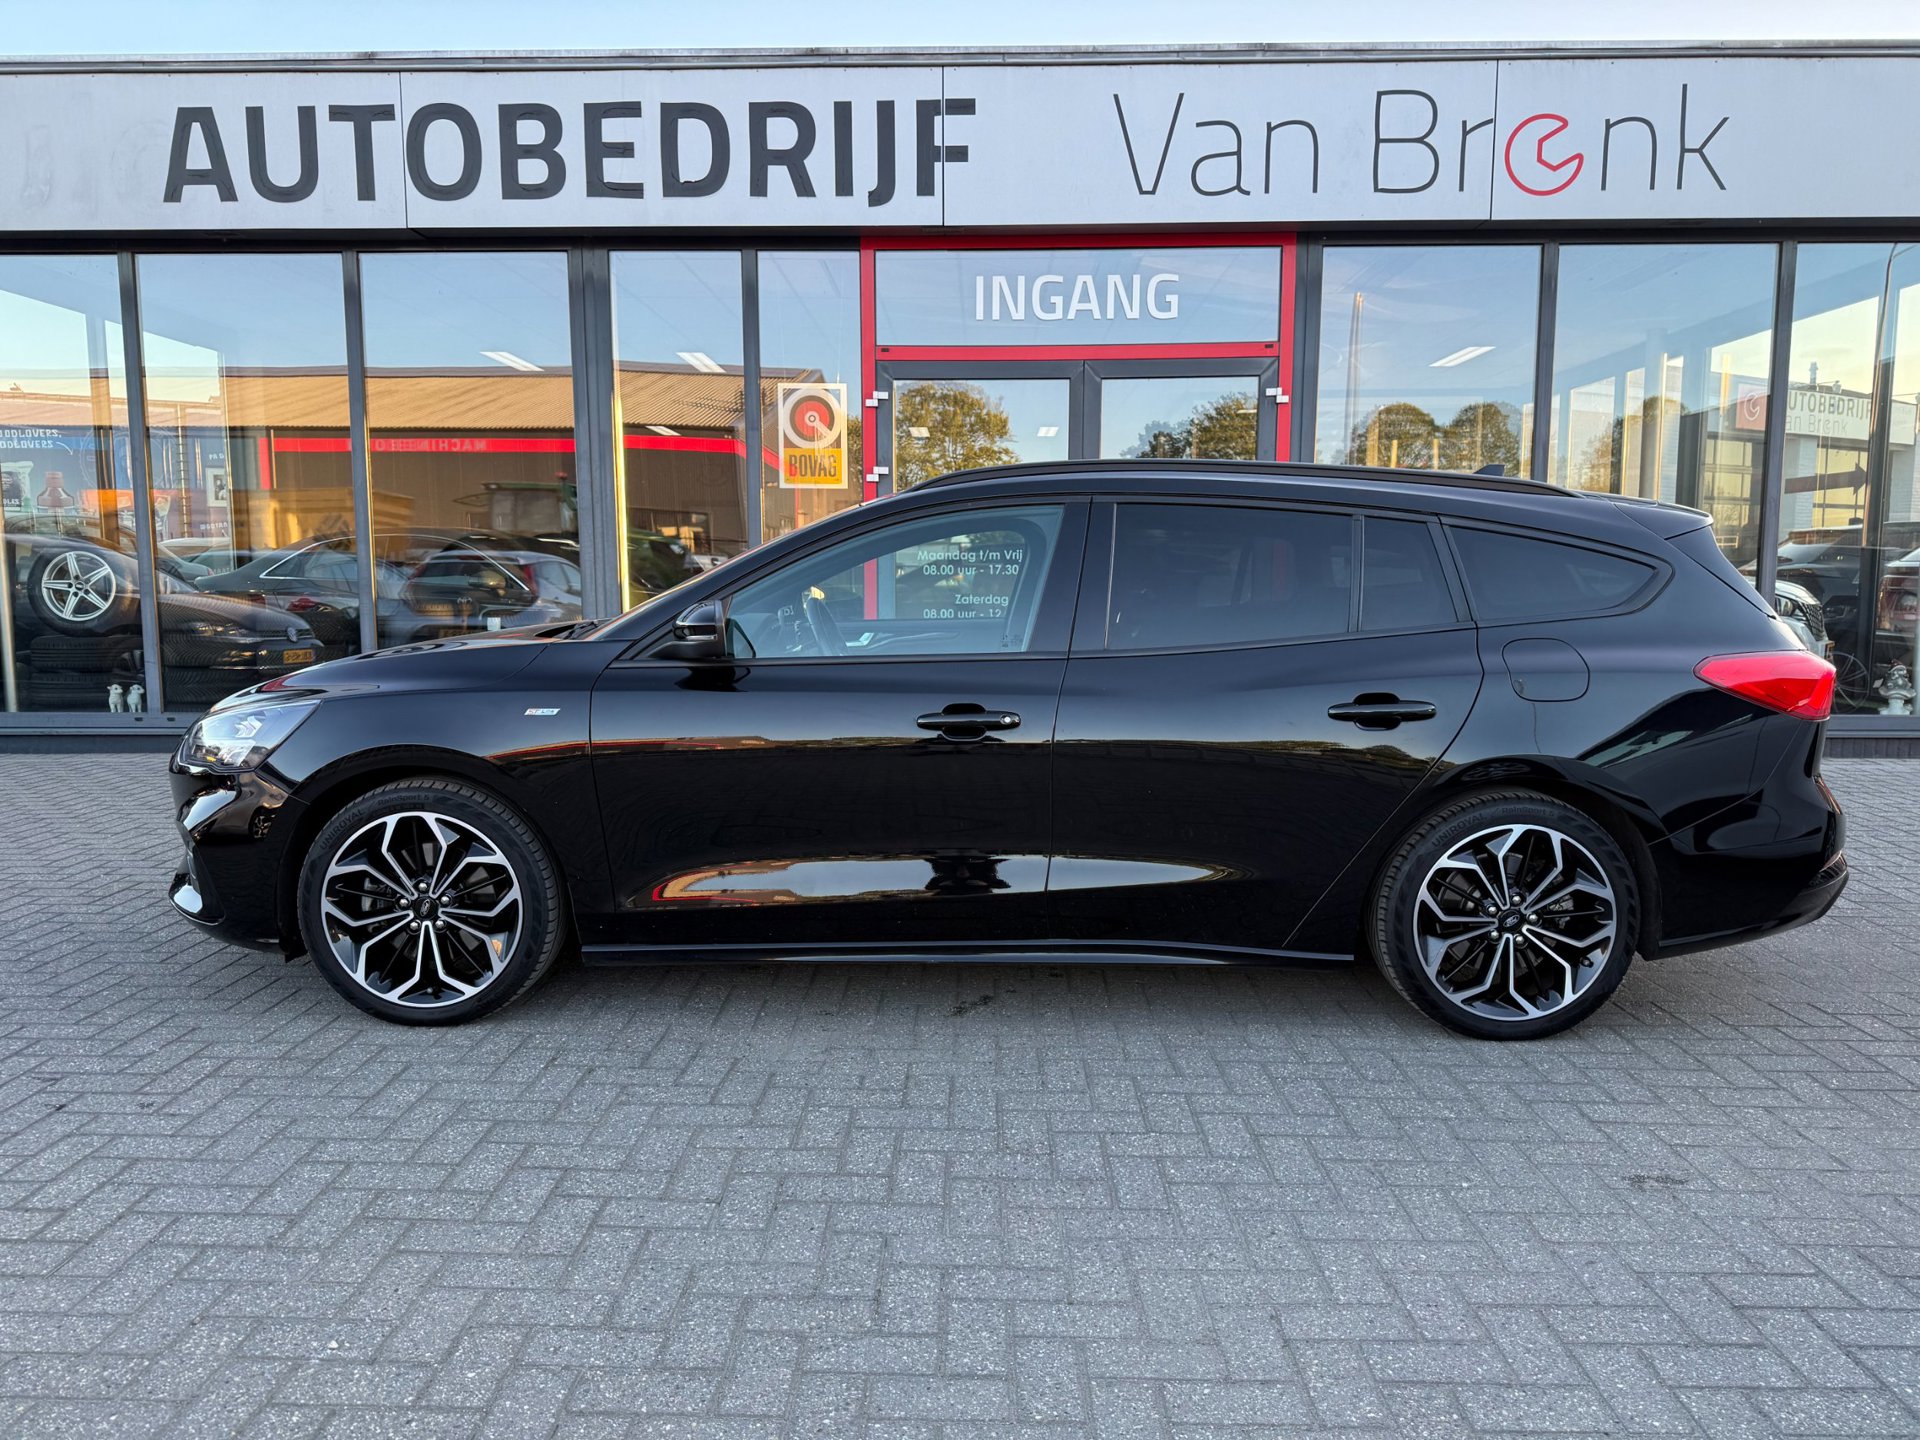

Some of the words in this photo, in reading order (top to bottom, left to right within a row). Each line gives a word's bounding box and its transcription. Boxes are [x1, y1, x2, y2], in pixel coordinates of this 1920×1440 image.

[163, 97, 976, 207] AUTOBEDRIJF
[1113, 92, 1319, 197] Van
[974, 273, 1180, 321] INGANG
[788, 454, 837, 478] BOVAG
[917, 550, 976, 563] Maandag
[979, 549, 1000, 561] t/m
[1004, 549, 1023, 563] Vrij
[922, 564, 954, 575] 08.00
[957, 566, 977, 575] uur
[988, 564, 1019, 575] 17.30
[954, 594, 1009, 607] Zaterdag
[922, 608, 954, 619] 08.00
[957, 610, 977, 619] uur
[320, 808, 366, 850] UNIROYAL
[1431, 812, 1488, 847] UNIROYAL
